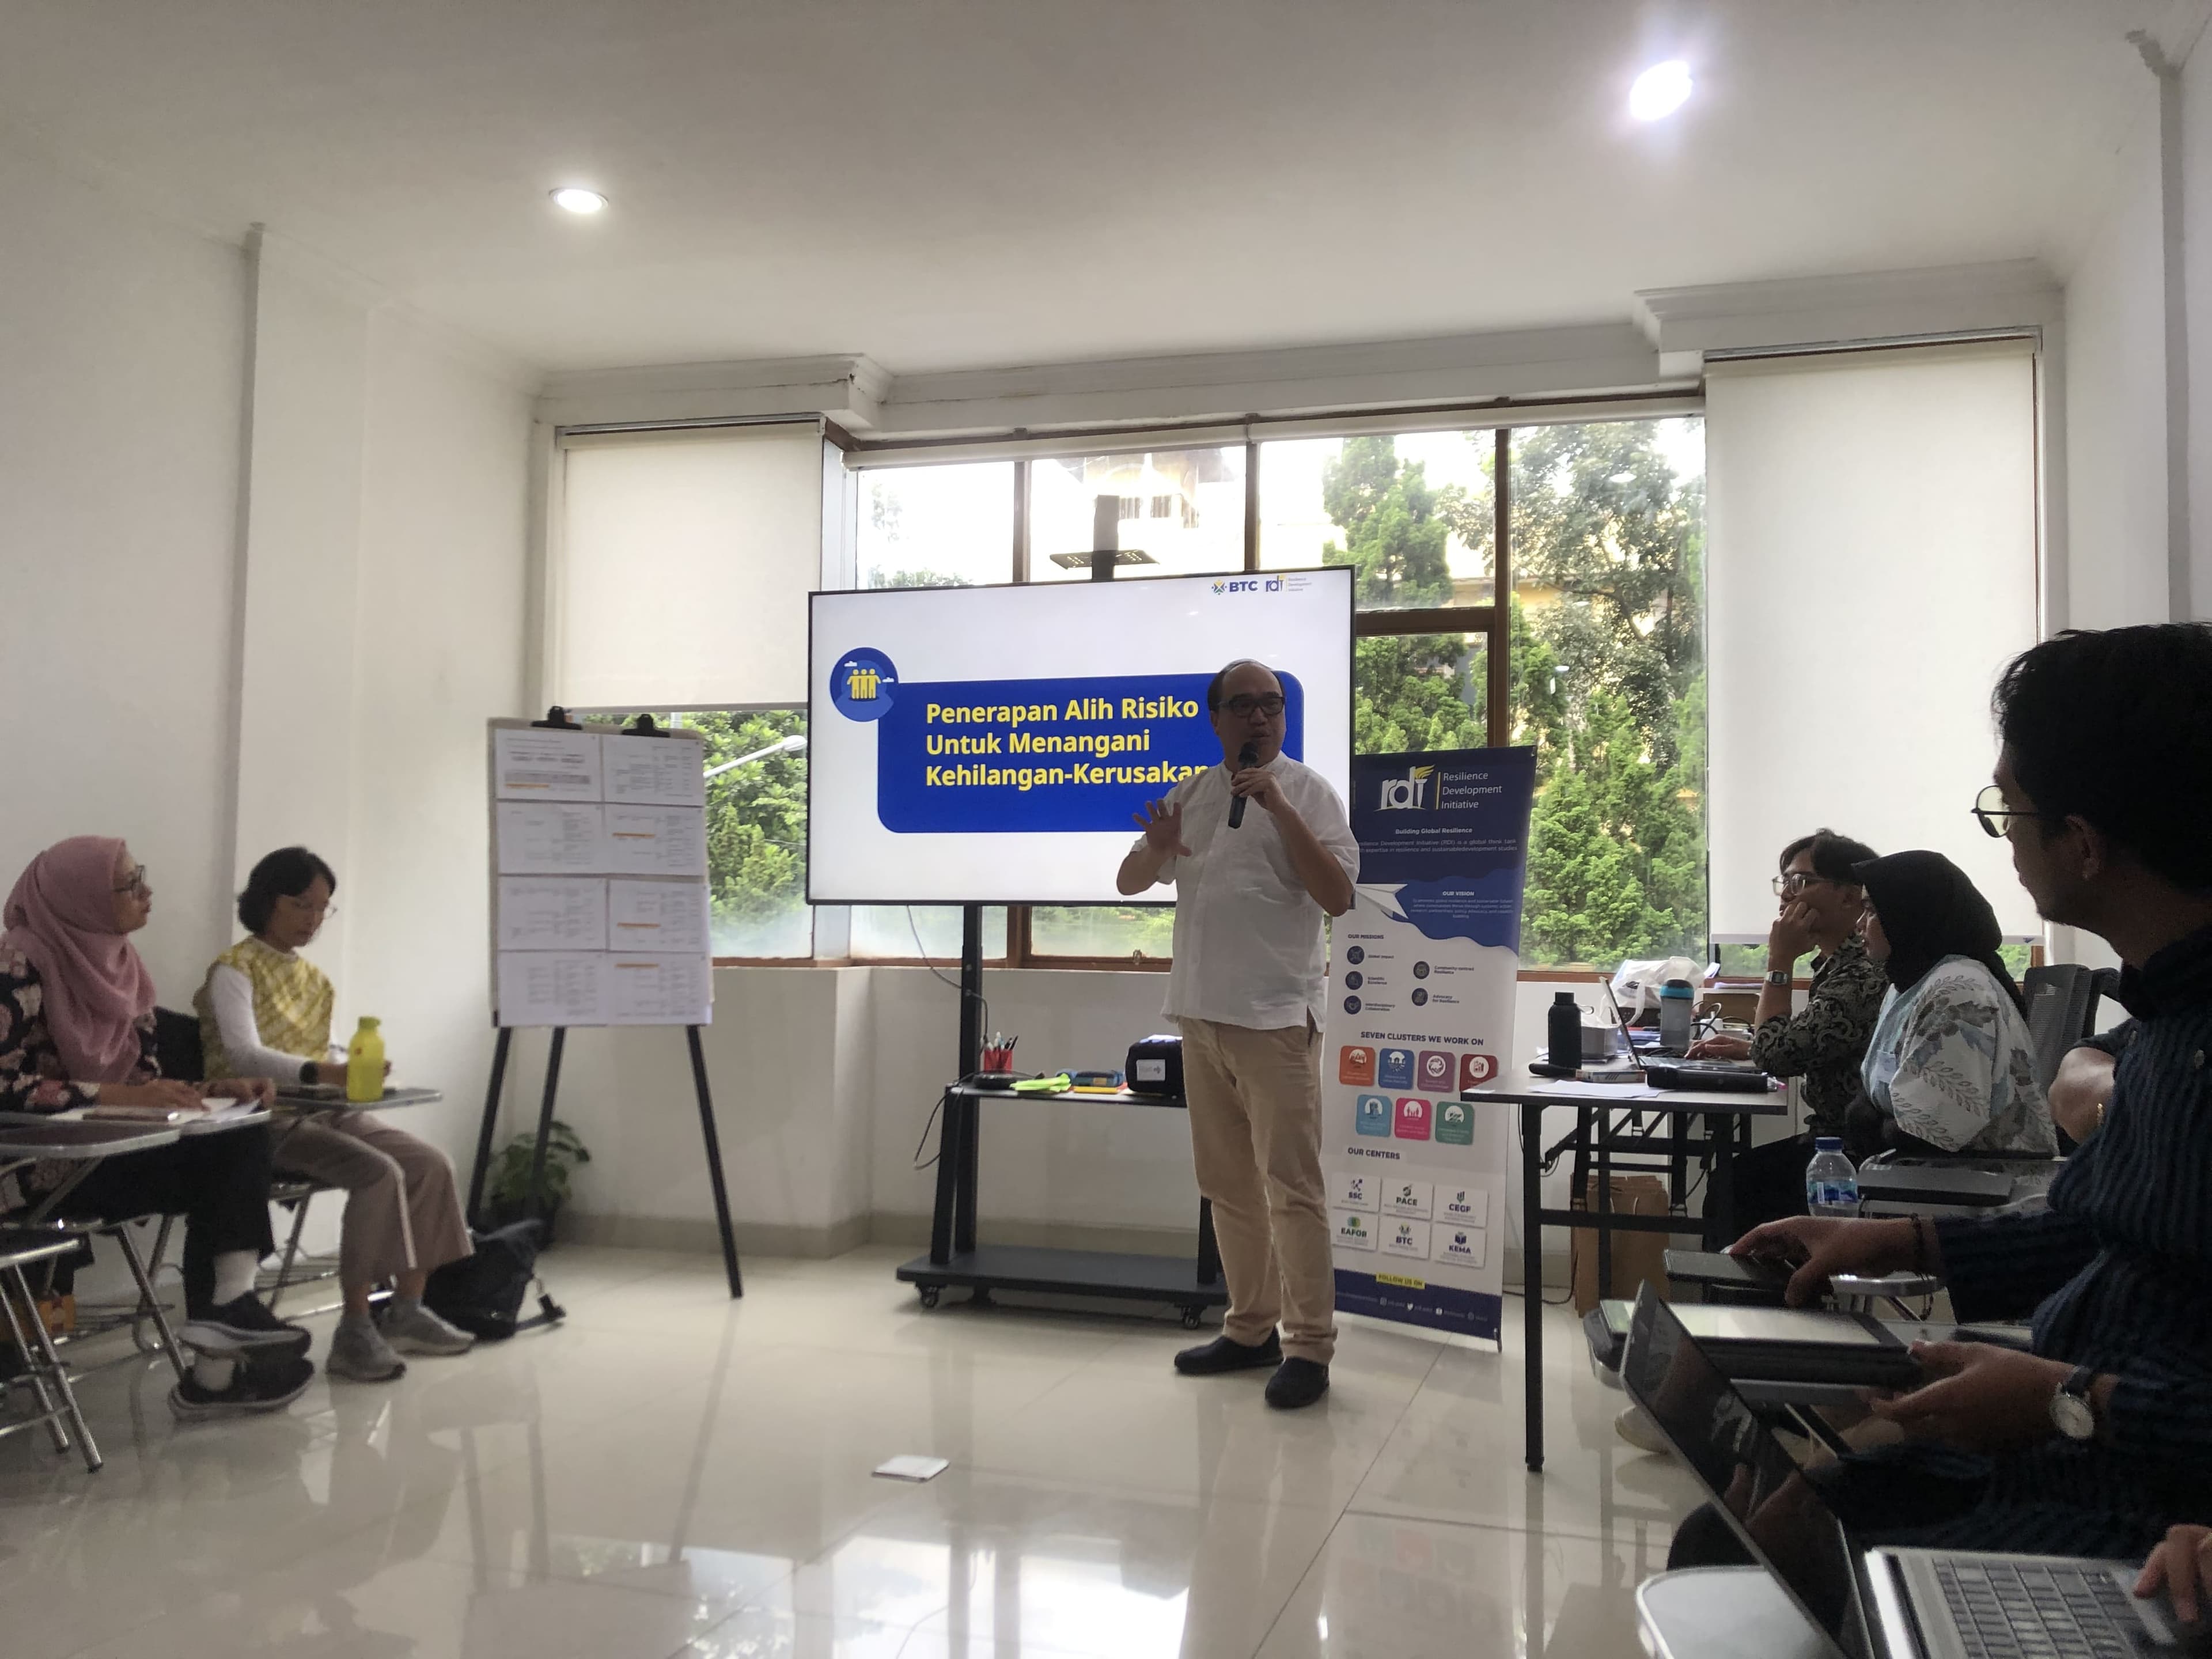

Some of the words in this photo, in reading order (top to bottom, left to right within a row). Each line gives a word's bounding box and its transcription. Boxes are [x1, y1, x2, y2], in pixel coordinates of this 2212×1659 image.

[1229, 581, 1258, 592] BTC
[926, 703, 1058, 728] Penerapan
[1065, 698, 1113, 721] Alih
[1122, 696, 1199, 718] Risiko
[926, 732, 1002, 755] Untuk
[1009, 729, 1150, 757] Menangani
[1443, 772, 1488, 781] Resilience
[1442, 785, 1502, 796] Development
[1441, 801, 1479, 809] Initiative
[1361, 1031, 1385, 1039] SEVEN
[1387, 1033, 1426, 1042] CLUSTERS
[1444, 1036, 1469, 1045] WORK
[1471, 1038, 1484, 1046] ON
[1348, 1147, 1363, 1156] OUR
[1366, 1149, 1400, 1160] CENTERS
[1396, 1196, 1418, 1206] PACE
[1396, 1236, 1412, 1245] BTC
[1378, 1274, 1403, 1283] FOLLOW
